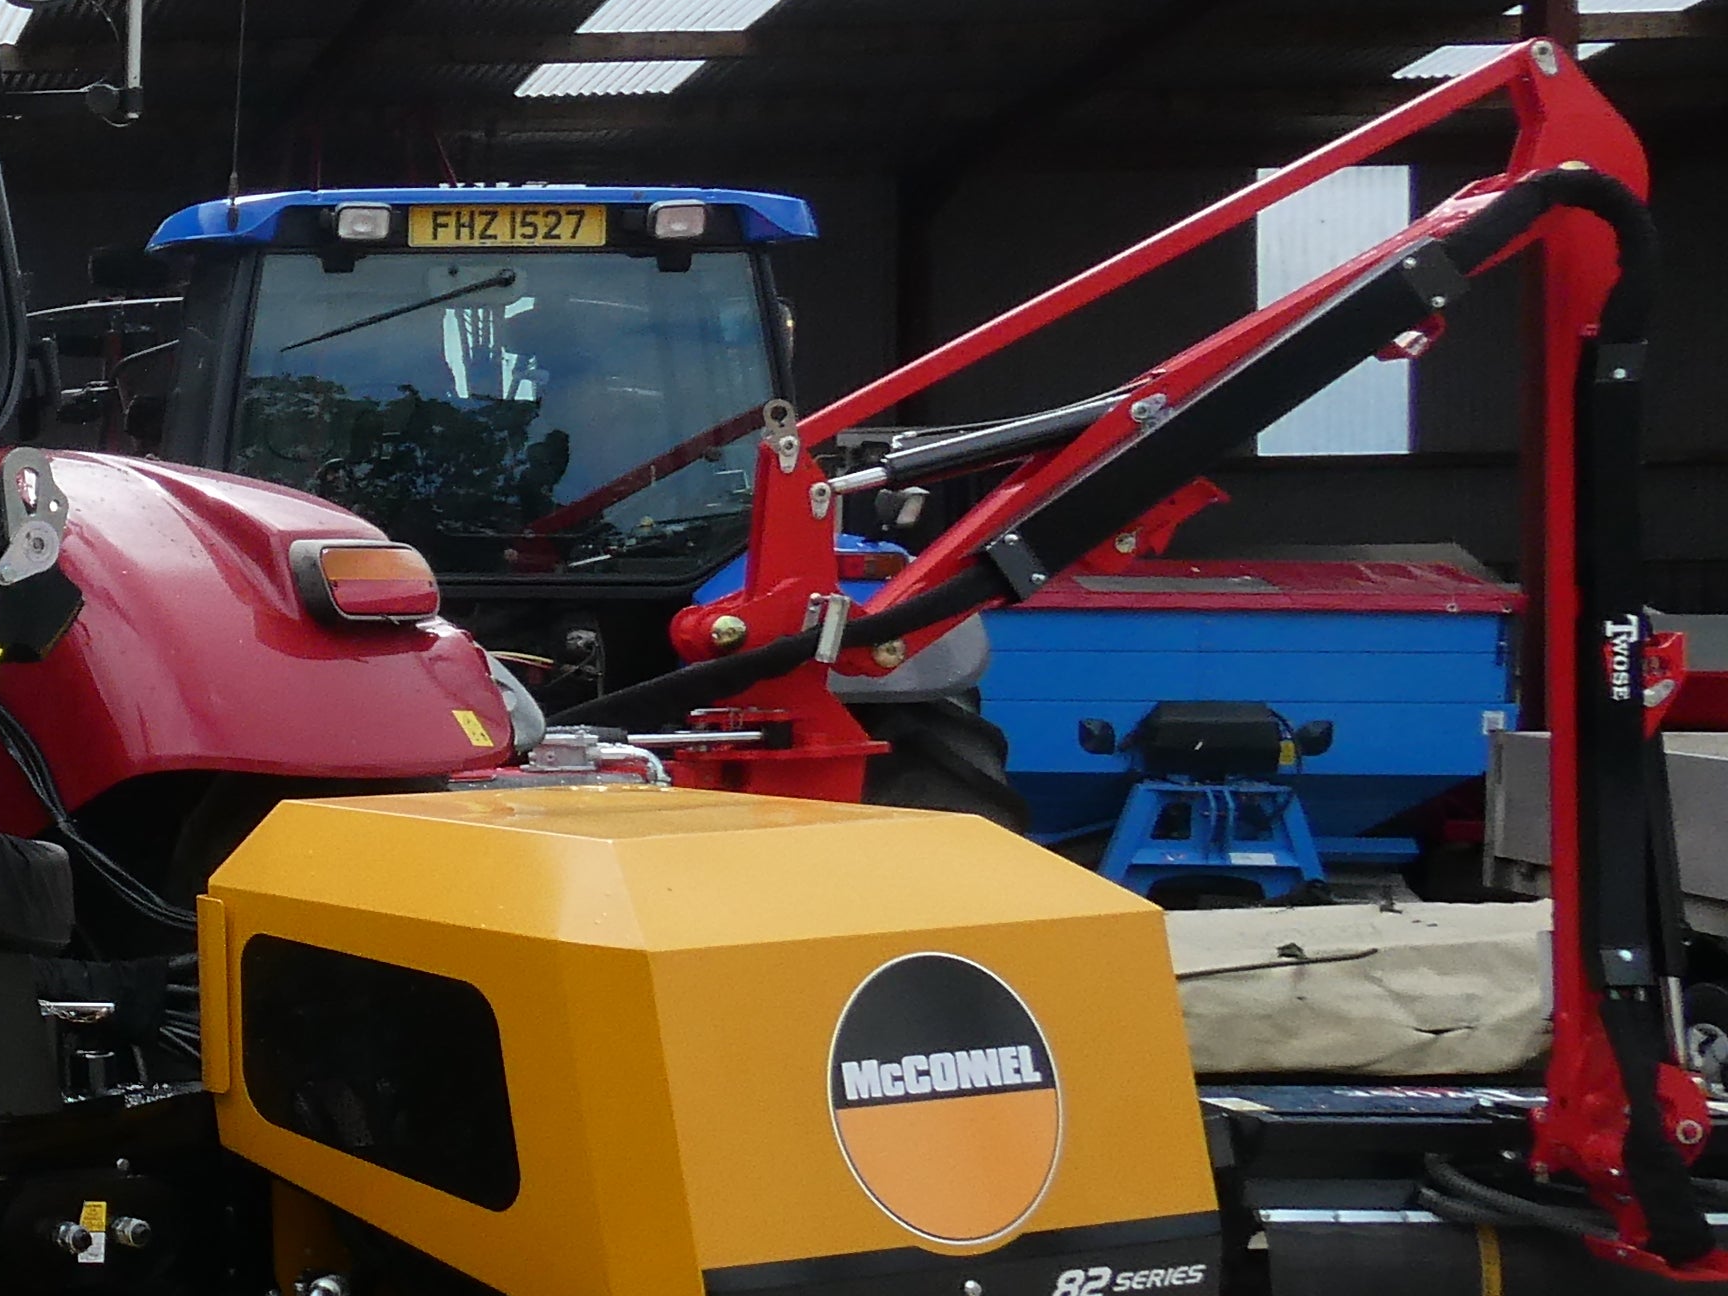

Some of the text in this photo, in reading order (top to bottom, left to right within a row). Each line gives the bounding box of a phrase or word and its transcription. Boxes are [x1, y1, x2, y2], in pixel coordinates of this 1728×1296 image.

[431, 209, 585, 240] FHZ 1527
[1112, 1263, 1207, 1293] SERIES
